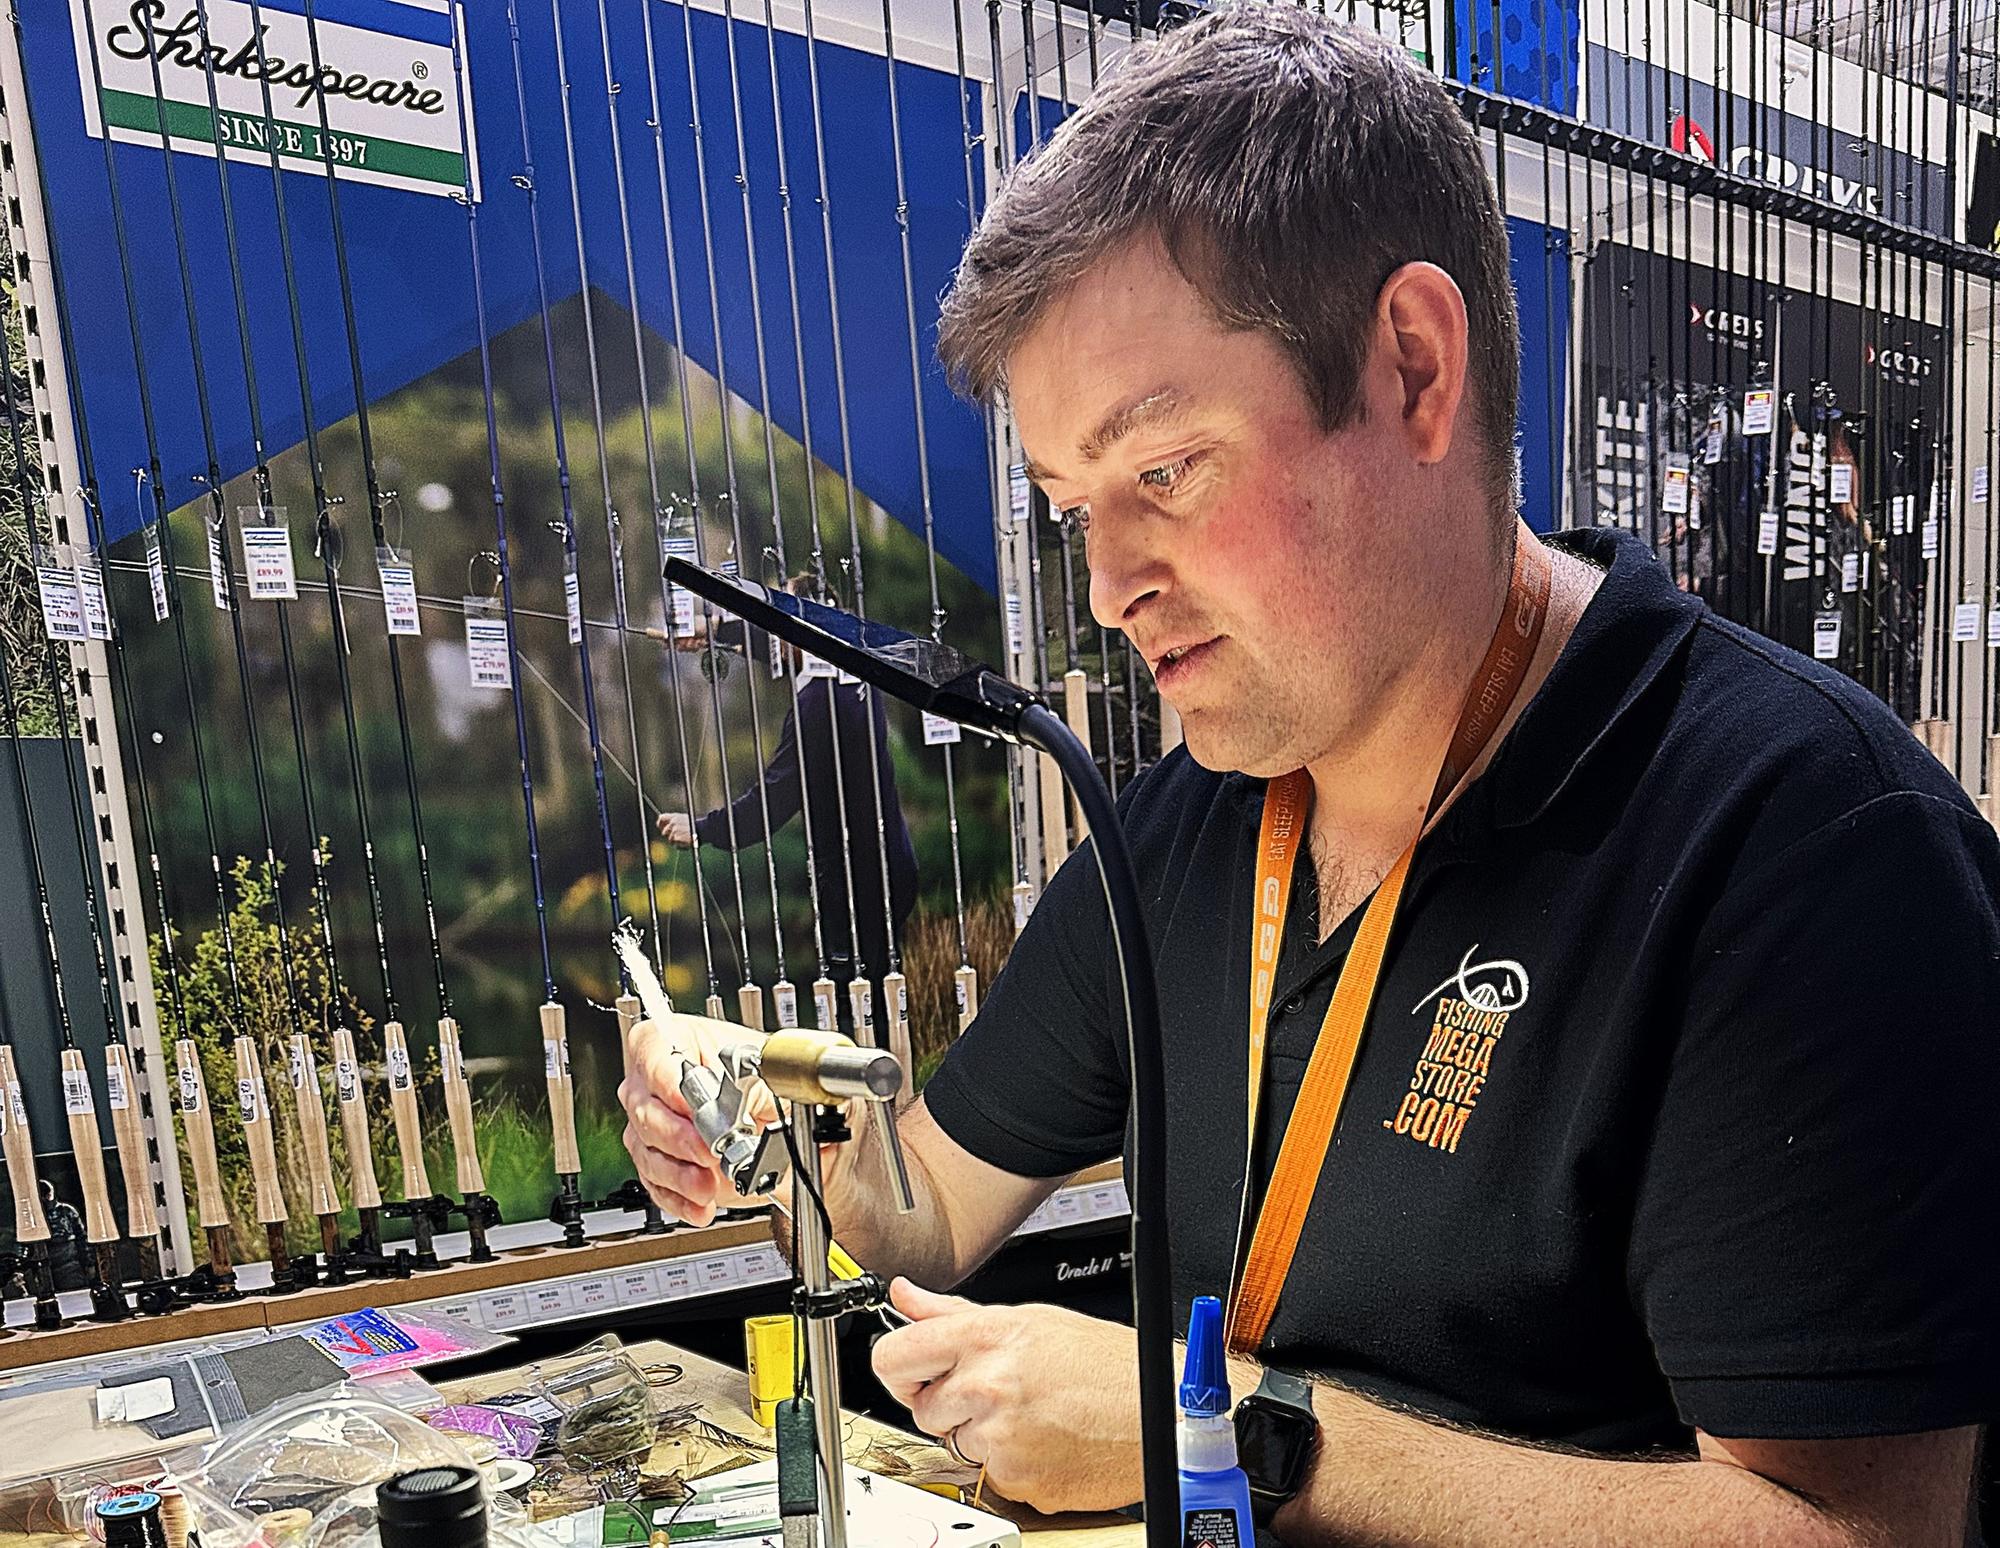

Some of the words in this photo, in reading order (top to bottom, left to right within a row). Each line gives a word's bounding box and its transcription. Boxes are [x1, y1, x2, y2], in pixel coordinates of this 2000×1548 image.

[107, 0, 445, 115] Shakespeare
[1496, 646, 1519, 675] EAT
[1480, 671, 1508, 717] SLEEP
[1271, 808, 1293, 839] SLEEP
[1268, 839, 1285, 862] EAT
[1435, 997, 1510, 1039] FISHING
[1421, 1023, 1498, 1077] MEGA
[1410, 1060, 1486, 1107] STORE
[1383, 1091, 1473, 1154] .COM
[1057, 1257, 1099, 1281] Oracle
